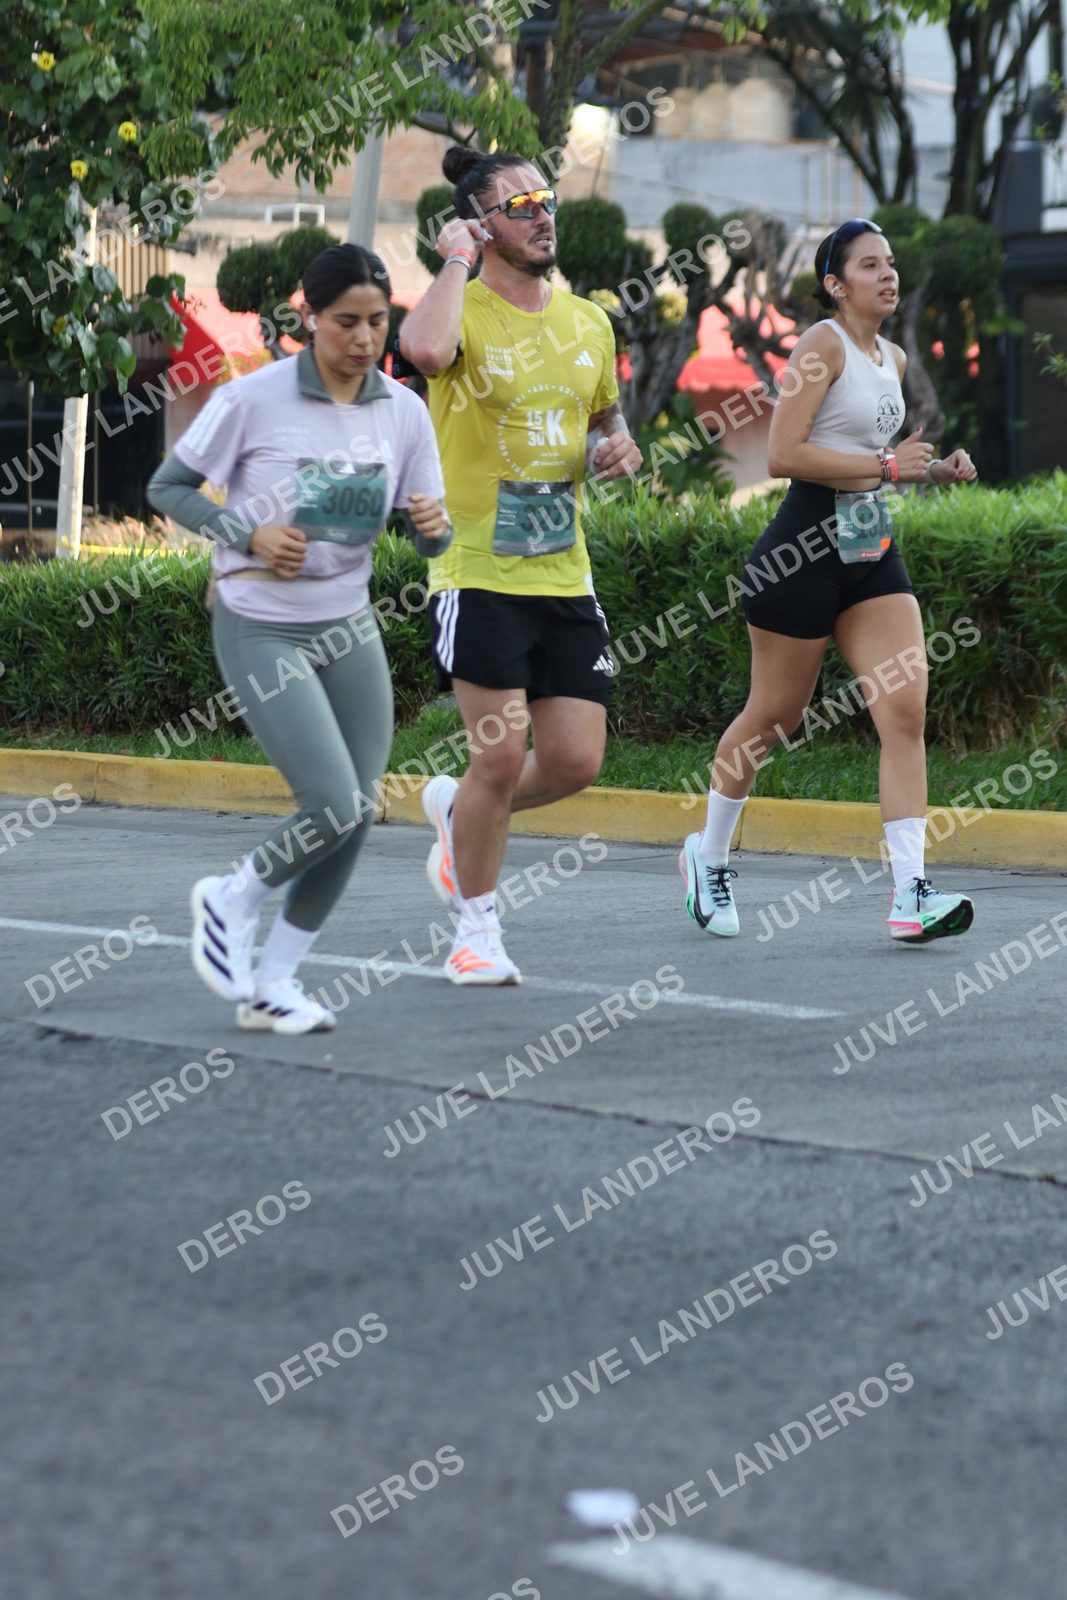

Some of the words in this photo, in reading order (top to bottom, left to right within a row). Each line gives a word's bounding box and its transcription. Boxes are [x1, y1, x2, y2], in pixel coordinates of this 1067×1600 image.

[526, 410, 542, 426] 15
[546, 409, 568, 446] K
[528, 431, 545, 446] 30
[322, 484, 384, 518] 3060
